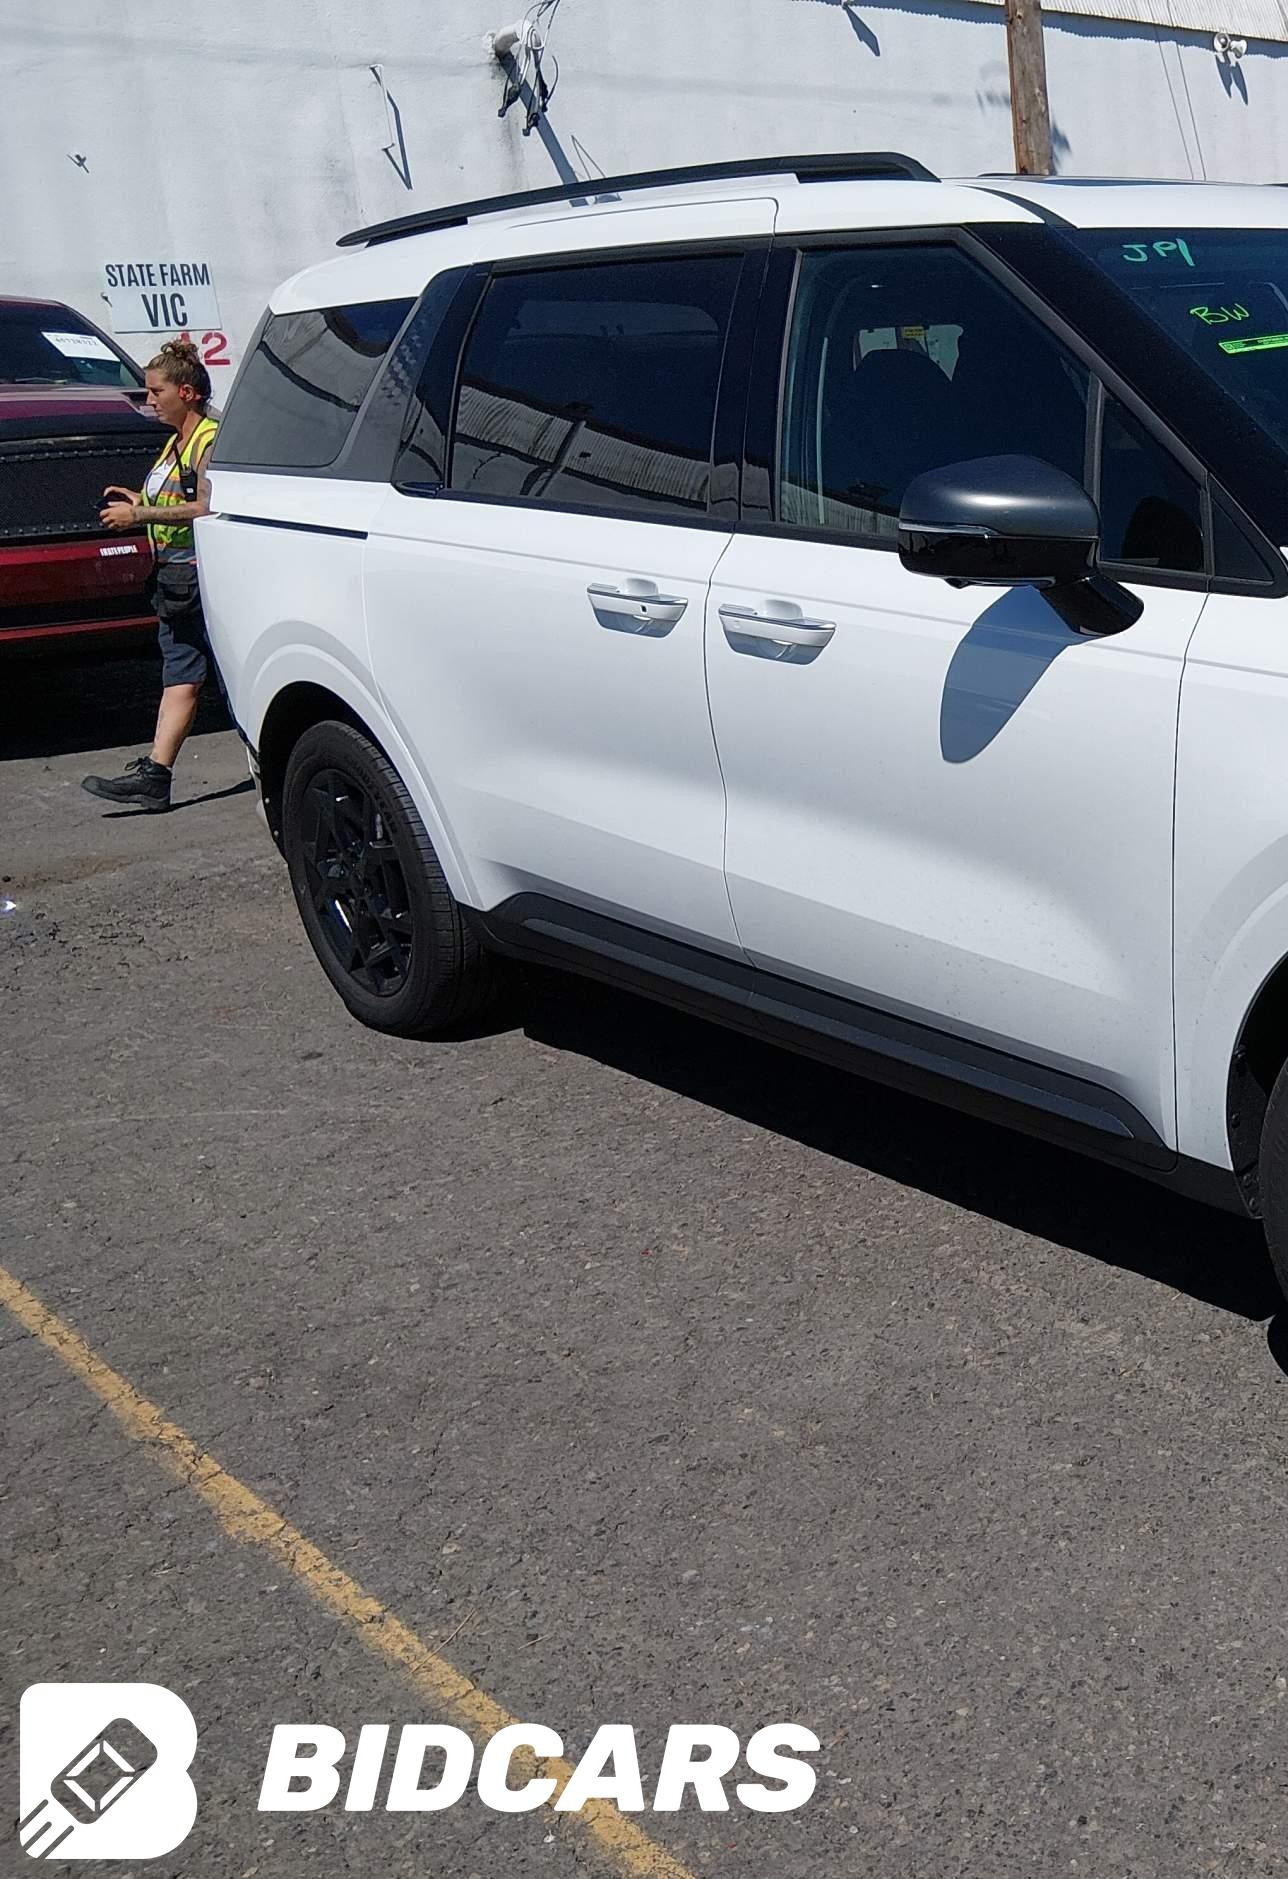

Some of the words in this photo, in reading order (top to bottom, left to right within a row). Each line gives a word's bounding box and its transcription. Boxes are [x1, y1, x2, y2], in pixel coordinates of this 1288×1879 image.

[105, 263, 157, 288] STATE
[159, 263, 210, 287] FARM
[141, 292, 188, 327] VIC
[1190, 303, 1250, 325] BW
